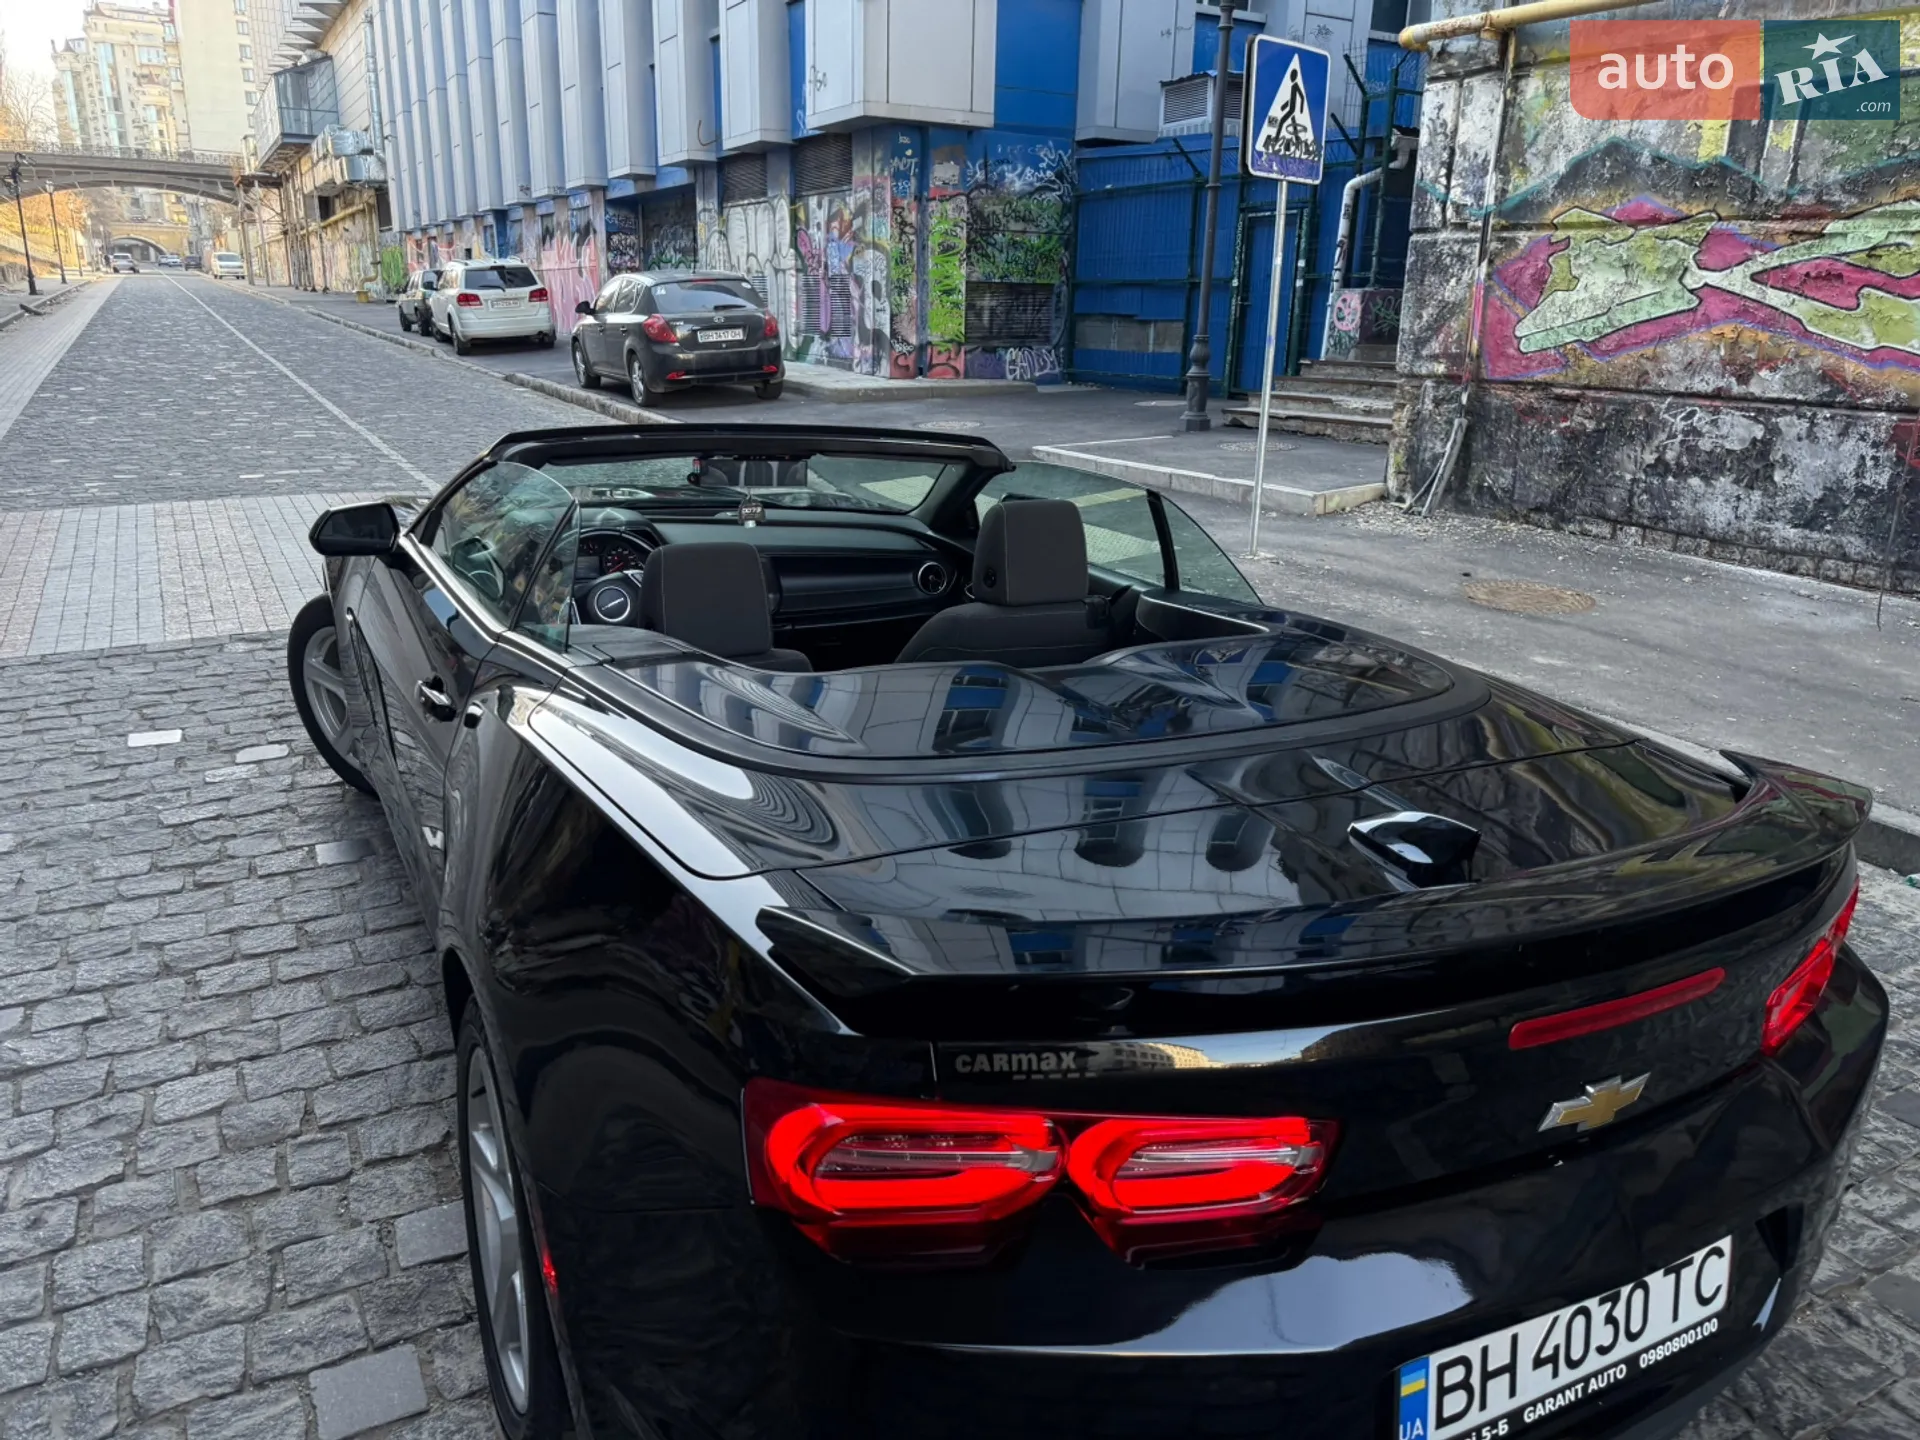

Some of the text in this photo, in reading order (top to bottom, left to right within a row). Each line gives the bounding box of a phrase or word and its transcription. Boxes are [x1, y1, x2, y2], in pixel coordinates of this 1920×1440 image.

[1434, 1245, 1726, 1431] BH 4030 TC
[1522, 1382, 1584, 1423] GARANT
[1587, 1364, 1628, 1394] AUTO
[1639, 1318, 1720, 1369] 0980800100
[1399, 1417, 1424, 1440] UA
